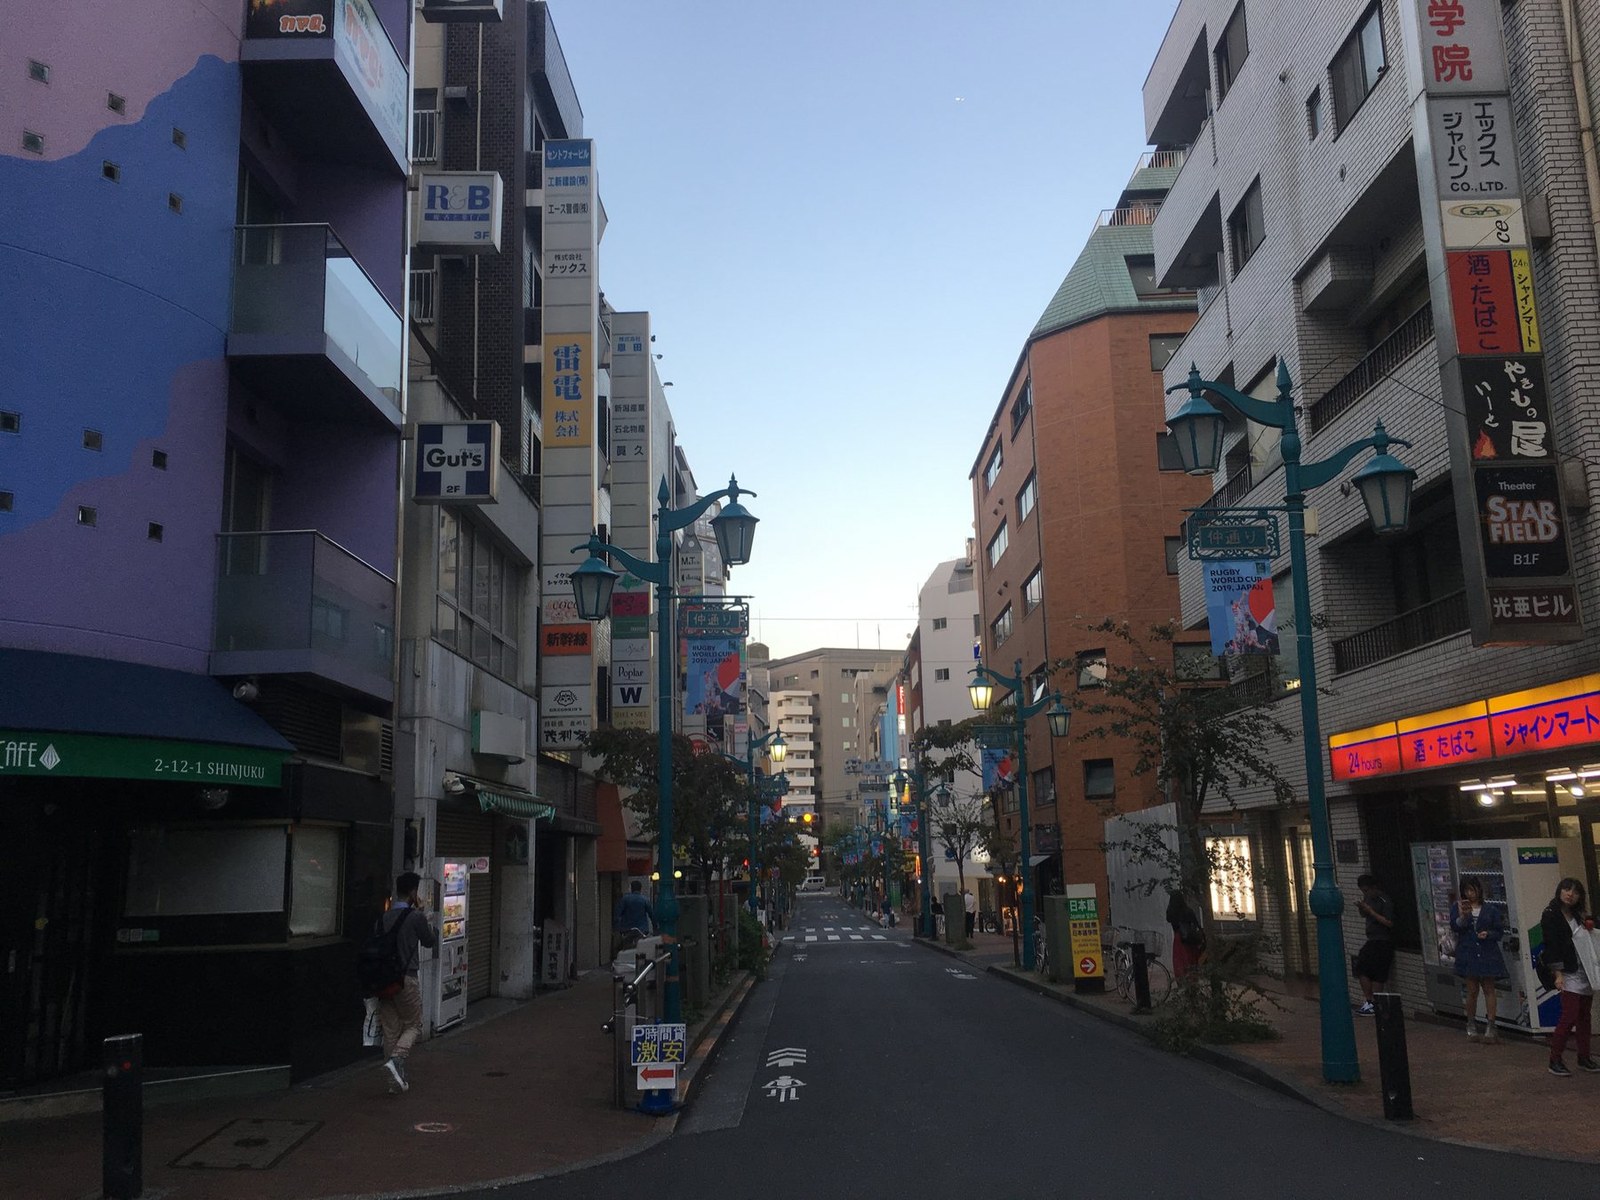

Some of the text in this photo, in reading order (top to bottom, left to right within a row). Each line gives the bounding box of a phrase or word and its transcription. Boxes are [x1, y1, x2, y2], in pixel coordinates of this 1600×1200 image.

[1428, 0, 1473, 83] 学院
[1474, 102, 1500, 167] エックス
[1443, 112, 1467, 179] ジャパン
[424, 184, 490, 210] R&B
[473, 230, 490, 240] 3F
[548, 263, 587, 274] ナックス
[1516, 273, 1536, 348] シャインマート
[554, 410, 579, 423] 株式
[555, 425, 580, 437] 会社
[426, 448, 483, 468] Gut's
[446, 485, 460, 493] 2F
[1498, 481, 1536, 491] Theater
[1487, 495, 1557, 522] STAR
[1208, 531, 1256, 545] 仲通り
[1490, 519, 1558, 542] FIELD
[1513, 553, 1540, 565] B1F
[1211, 576, 1263, 584] WORLD CUP
[1212, 584, 1235, 592] 2019,
[1493, 595, 1573, 618] 光亜ビル
[693, 614, 732, 626] 仲通り
[546, 632, 588, 647] 新幹線
[618, 666, 643, 681] Poplar
[620, 687, 642, 704] W
[1504, 704, 1600, 747] シャインマート
[154, 758, 265, 779] 2-12-1 SHINJUKU
[1349, 752, 1382, 773] 24 hours
[636, 1041, 683, 1063] 激安
